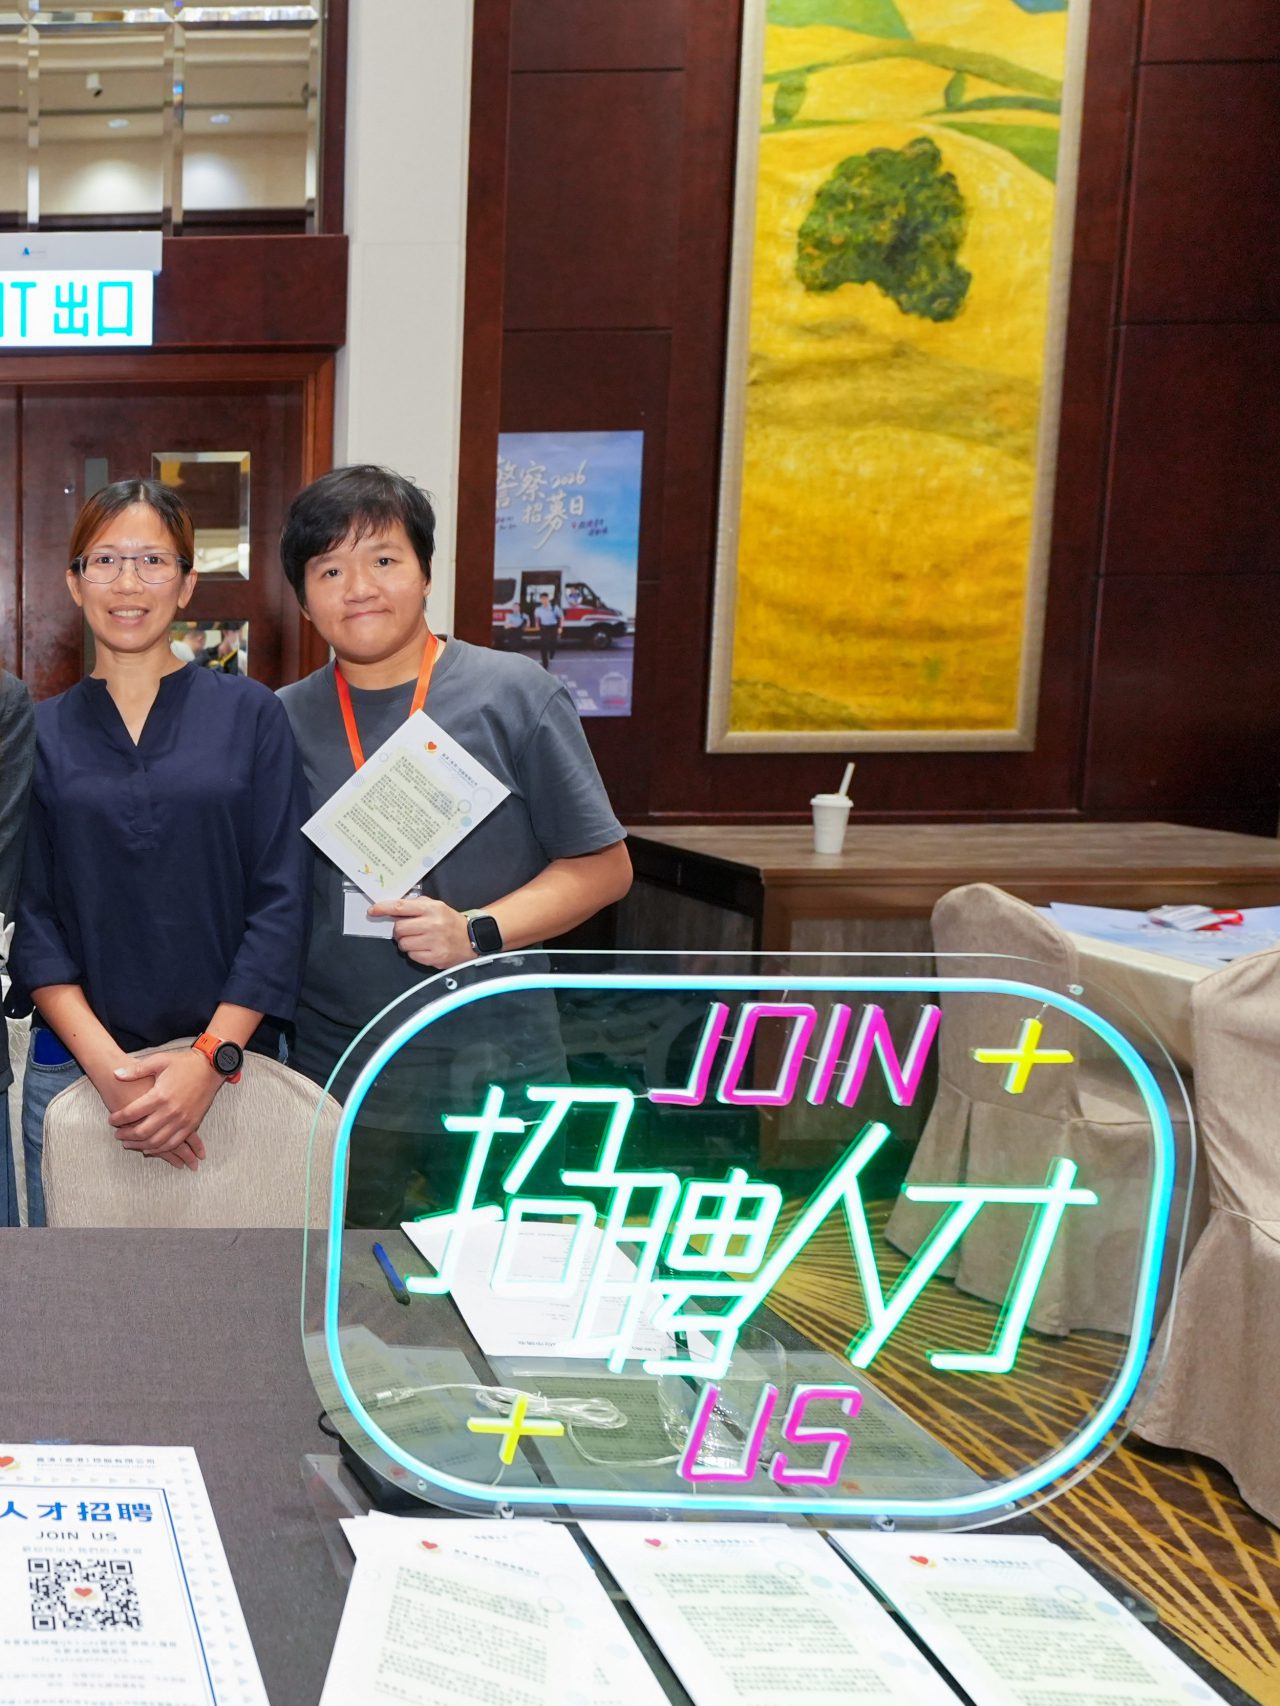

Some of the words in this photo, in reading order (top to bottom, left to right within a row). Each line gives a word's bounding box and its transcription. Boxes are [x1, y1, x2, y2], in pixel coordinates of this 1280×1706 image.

[53, 281, 133, 337] 出口
[648, 1002, 942, 1107] JOIN
[405, 1084, 1099, 1380] 招聘人才
[677, 1383, 863, 1486] US
[35, 1530, 80, 1540] JOIN
[91, 1531, 118, 1540] US
